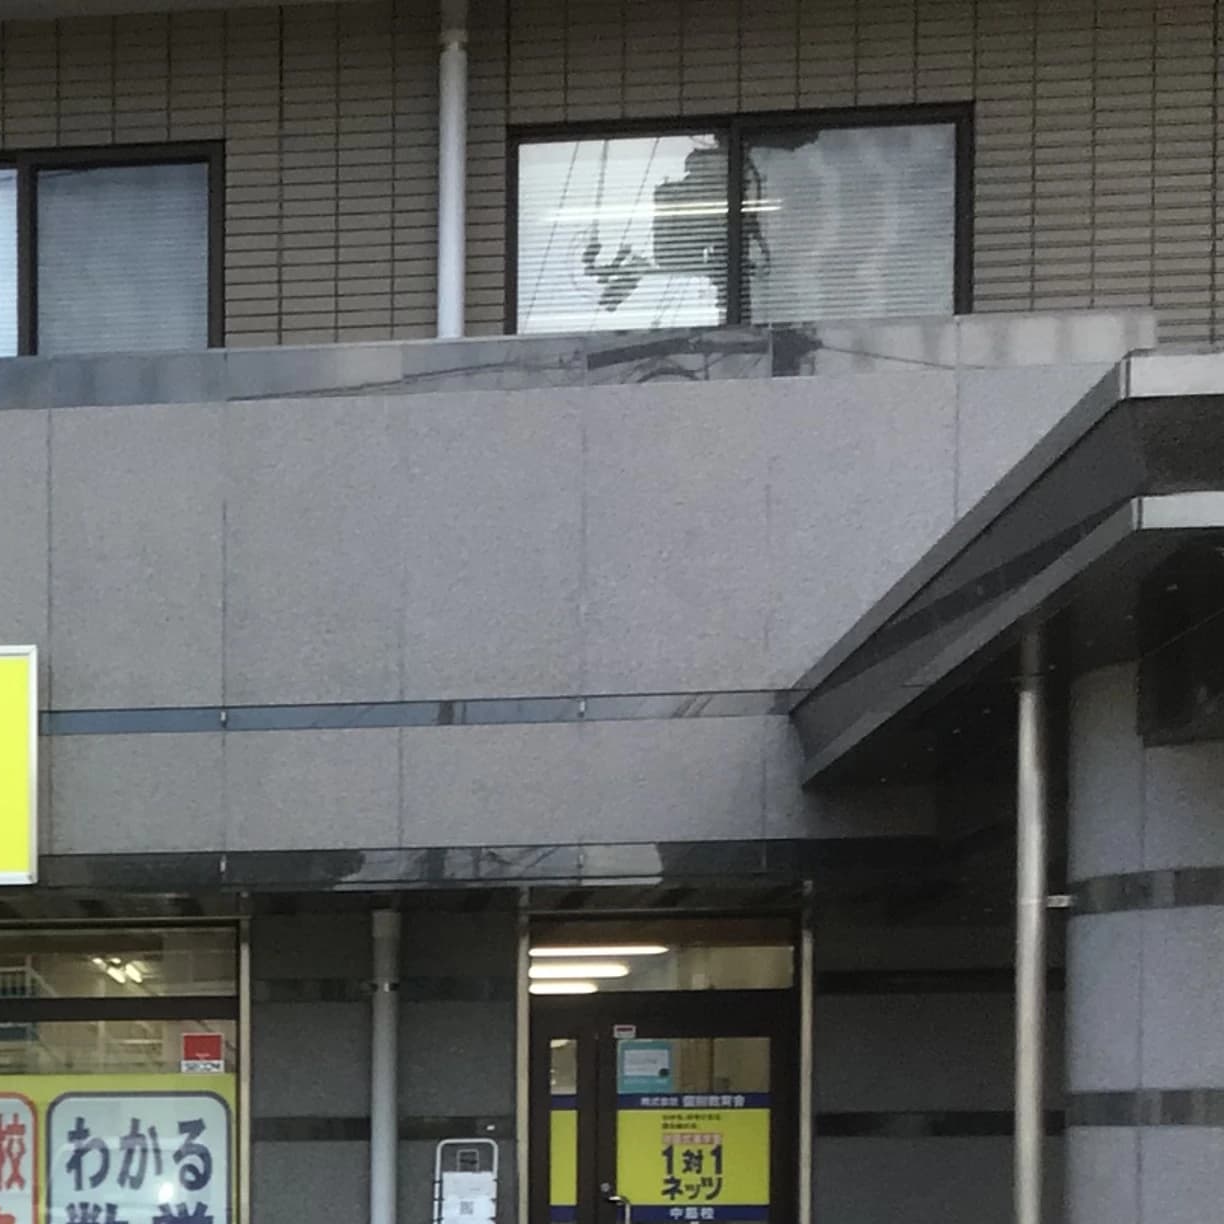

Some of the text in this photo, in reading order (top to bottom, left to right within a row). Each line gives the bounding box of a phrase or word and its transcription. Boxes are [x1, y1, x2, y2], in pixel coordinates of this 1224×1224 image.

[65, 1116, 214, 1192] わかる
[661, 1144, 723, 1175] 1対1
[661, 1175, 723, 1200] ネッツ
